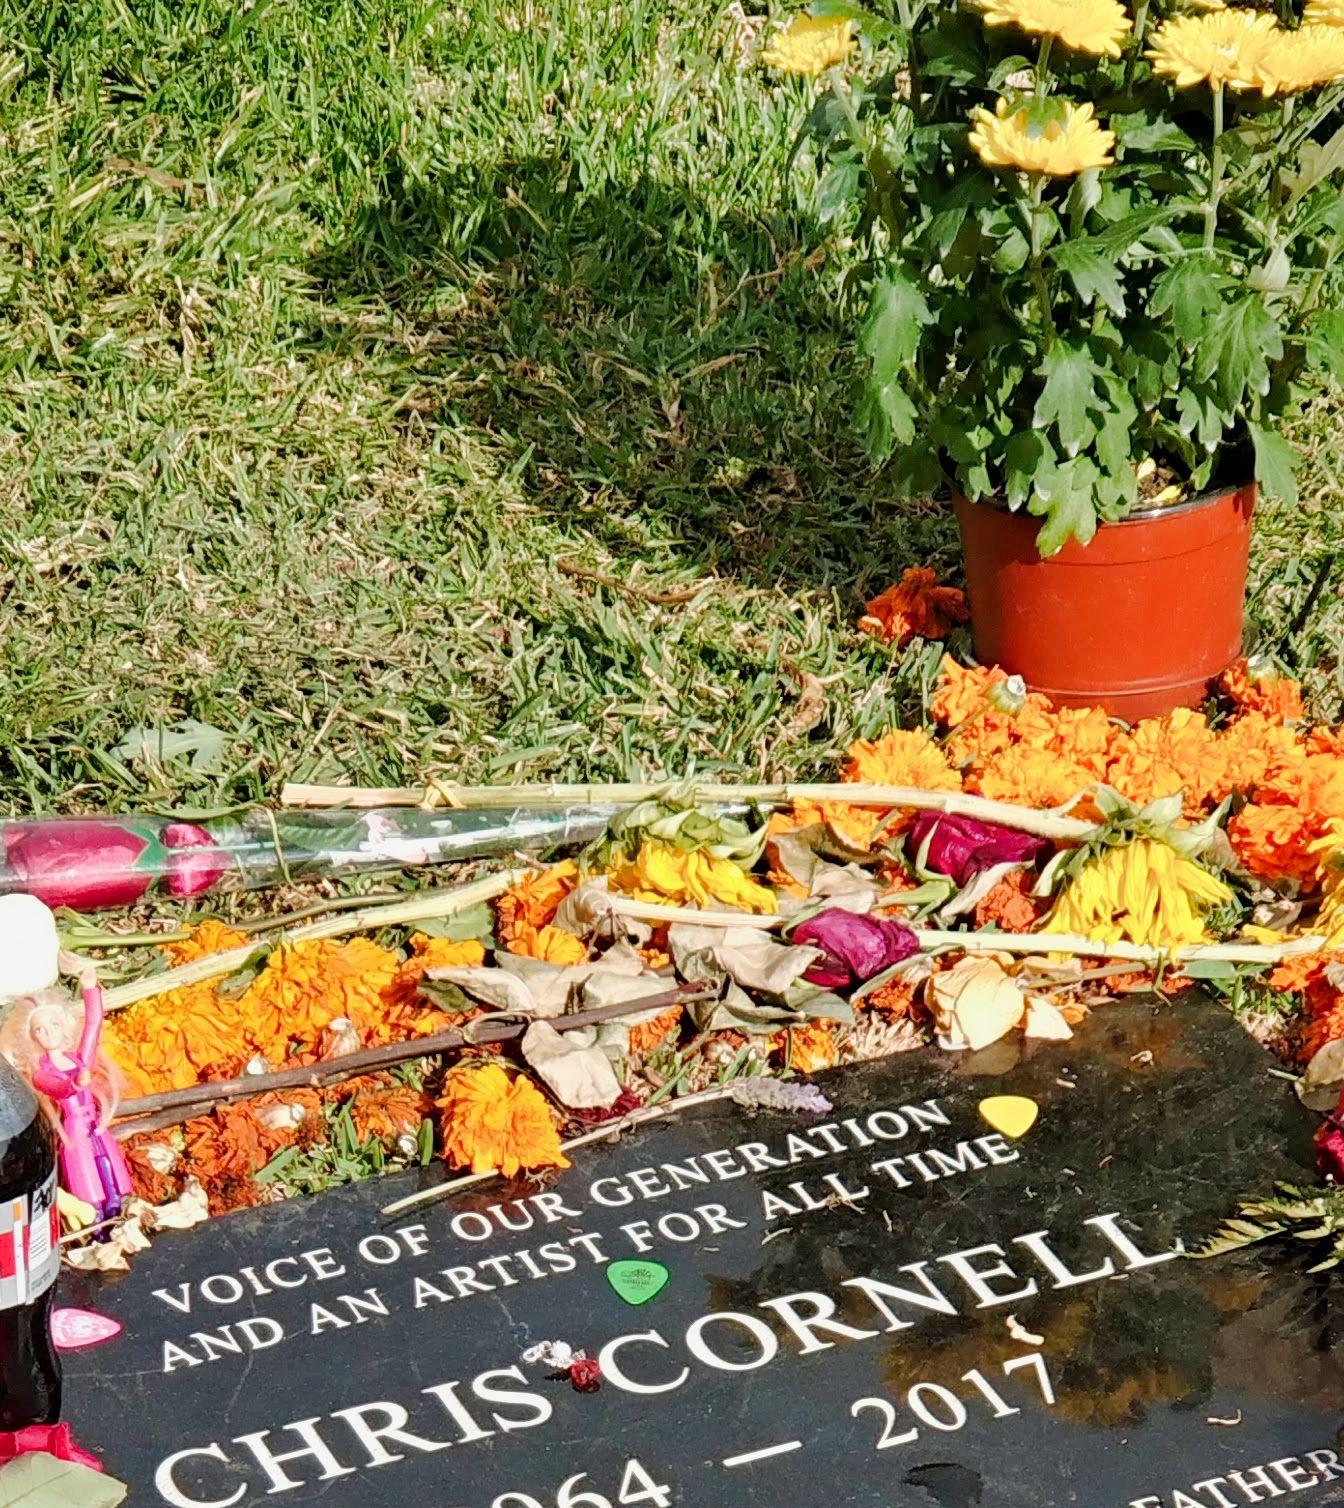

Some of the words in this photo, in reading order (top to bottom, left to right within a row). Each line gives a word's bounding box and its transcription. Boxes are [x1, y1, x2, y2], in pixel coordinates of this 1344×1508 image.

[151, 1247, 347, 1314] VOICE
[358, 1224, 429, 1265] OF
[449, 1192, 584, 1241] OUR
[589, 1098, 952, 1207] GENERATION
[162, 1317, 284, 1373] AND
[311, 1287, 390, 1335] AN
[413, 1232, 610, 1309] ARTIST
[619, 1203, 748, 1253] FOR
[762, 1173, 870, 1221] ALL
[871, 1133, 1020, 1188] TIME
[597, 1212, 1186, 1394] CORNELL
[850, 1352, 1056, 1450] 2017
